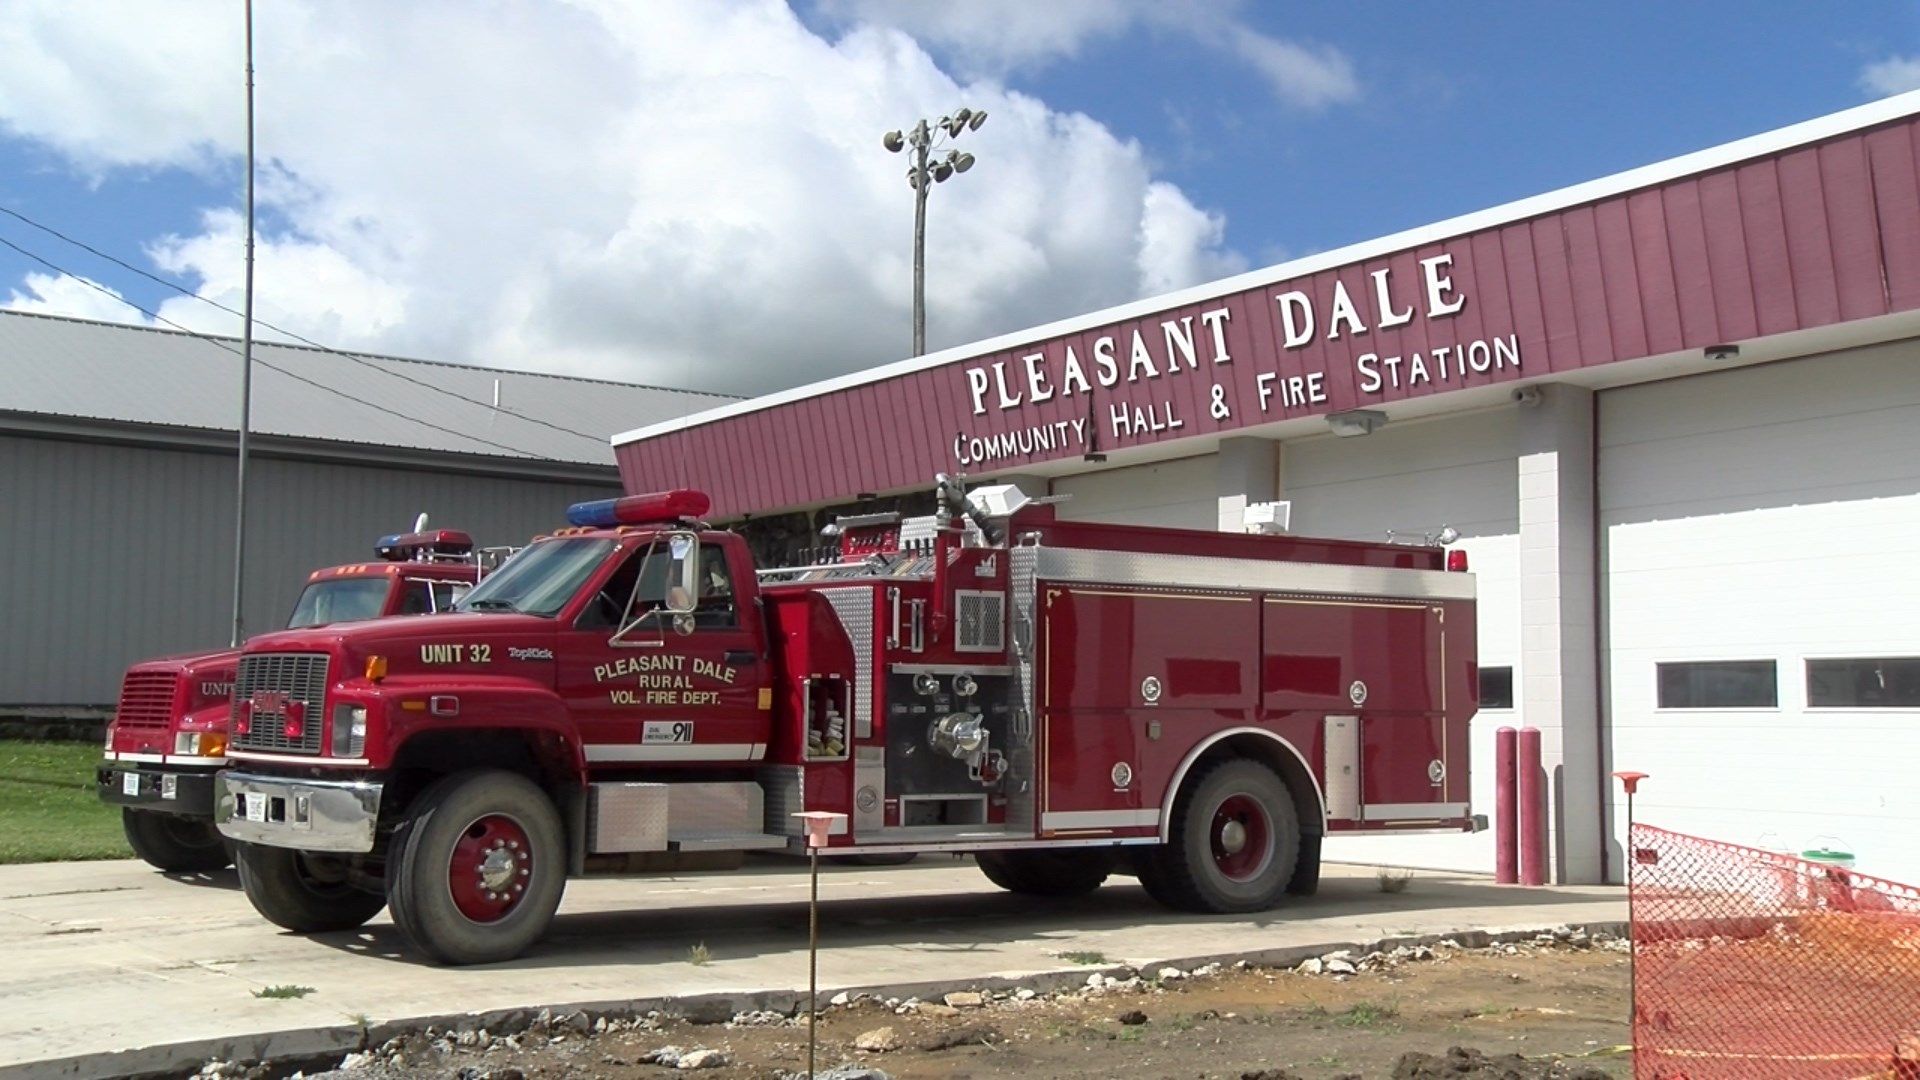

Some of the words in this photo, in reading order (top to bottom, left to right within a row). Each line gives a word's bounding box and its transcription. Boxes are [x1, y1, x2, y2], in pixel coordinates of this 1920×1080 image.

[966, 307, 1231, 415] PLEASANT
[1276, 253, 1465, 349] DALE
[955, 418, 1085, 465] COMMUNITY
[1110, 401, 1182, 437] HALL
[1210, 384, 1230, 419] &
[1257, 372, 1326, 411] FIRE
[1358, 334, 1520, 393] STATION
[421, 644, 464, 663] UNIT
[470, 644, 491, 662] 32
[594, 655, 685, 681] PLEASANT
[693, 658, 736, 683] DALE
[640, 675, 693, 688] RURAL
[610, 691, 640, 704] VOL.
[646, 691, 677, 704] FIRE
[682, 692, 721, 704] DEPT.
[673, 723, 691, 741] 911
